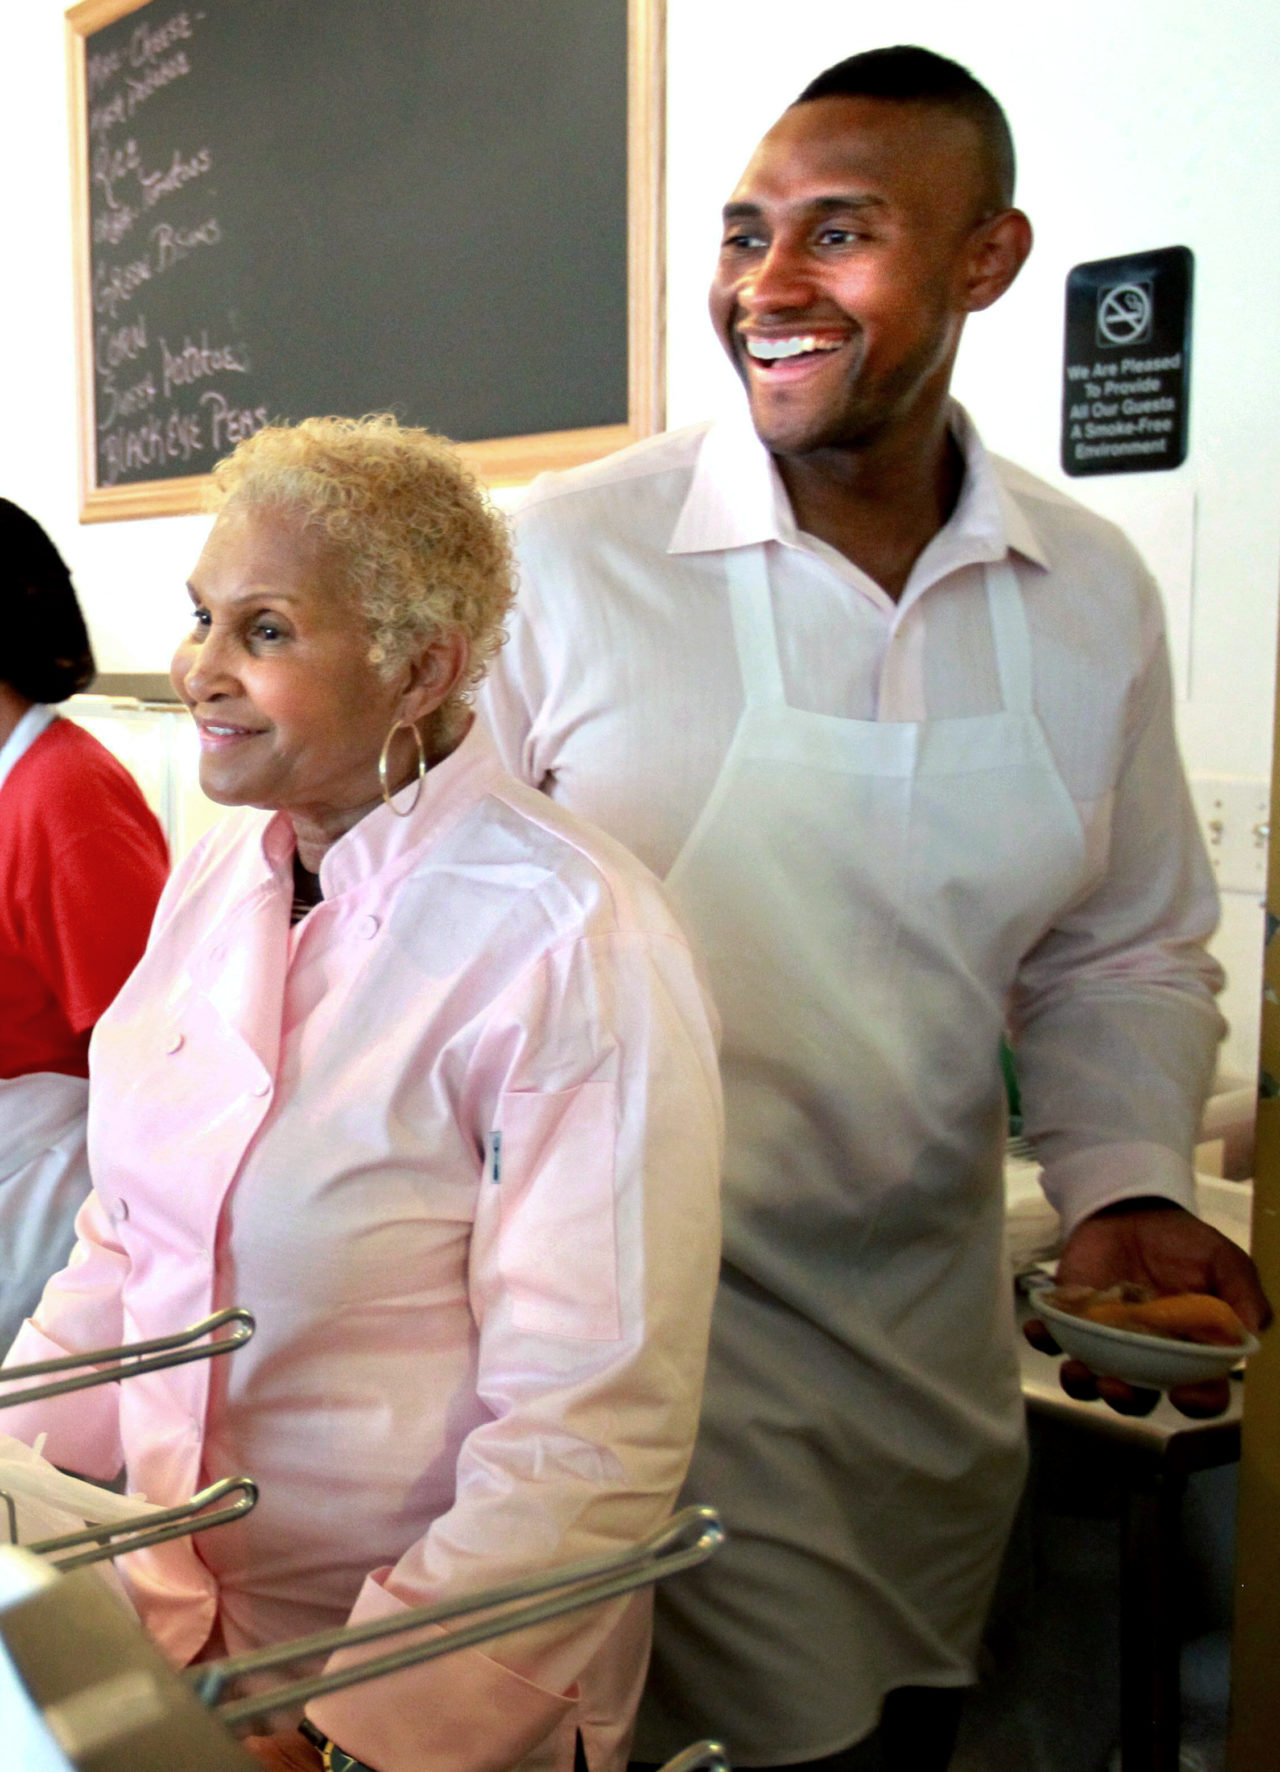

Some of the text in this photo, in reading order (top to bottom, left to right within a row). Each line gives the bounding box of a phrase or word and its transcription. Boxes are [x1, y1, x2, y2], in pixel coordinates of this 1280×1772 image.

[1067, 353, 1182, 381] We Are Pleased
[1084, 377, 1161, 398] To Provide
[1070, 397, 1175, 420] All Our Guests
[1070, 416, 1172, 440] A Smoke-Free
[1075, 439, 1168, 460] Environment
